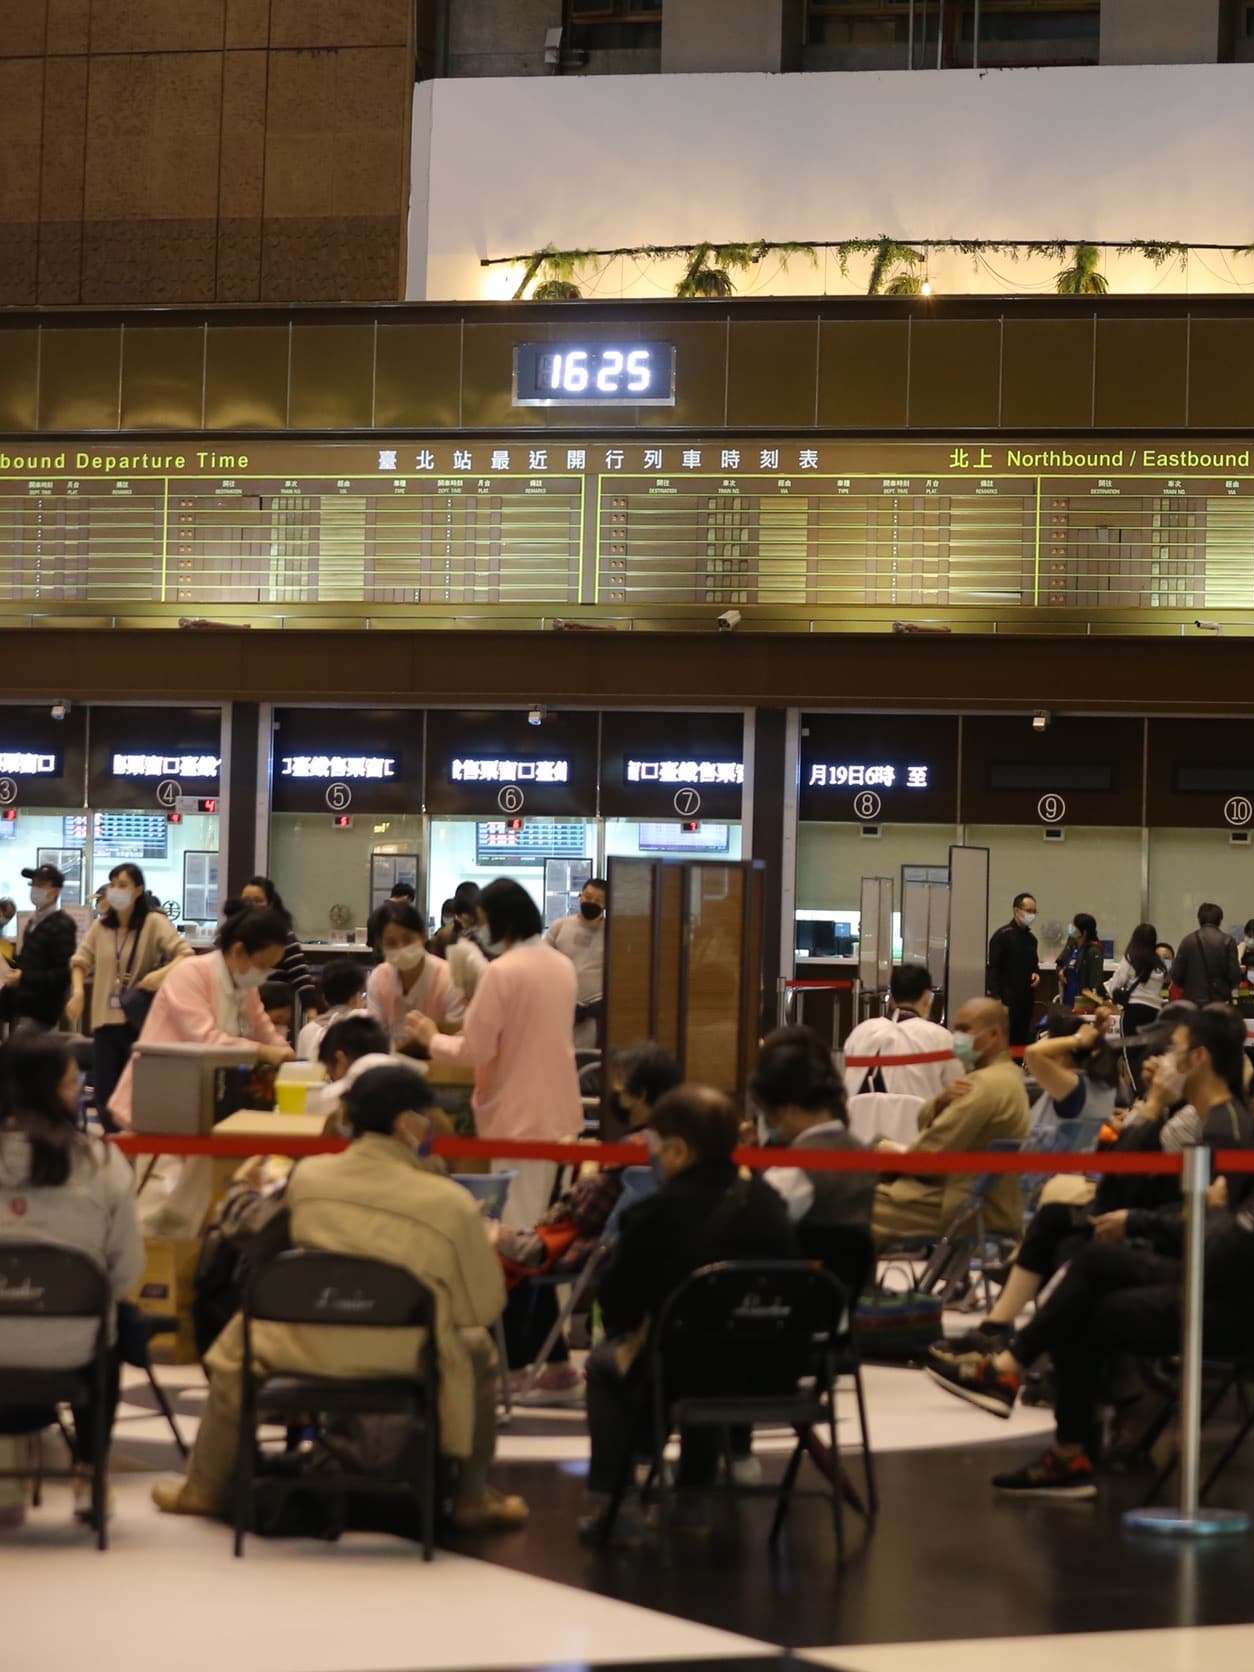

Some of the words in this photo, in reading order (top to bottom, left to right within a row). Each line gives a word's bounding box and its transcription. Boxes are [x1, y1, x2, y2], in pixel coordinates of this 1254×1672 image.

[76, 453, 186, 472] Departure
[196, 452, 249, 468] Time
[379, 450, 818, 469] 臺北站最近開行列車時刻表
[949, 449, 993, 468] 北上
[1007, 450, 1123, 467] Northbound
[1143, 450, 1250, 467] Eastbound
[907, 766, 928, 787] 至
